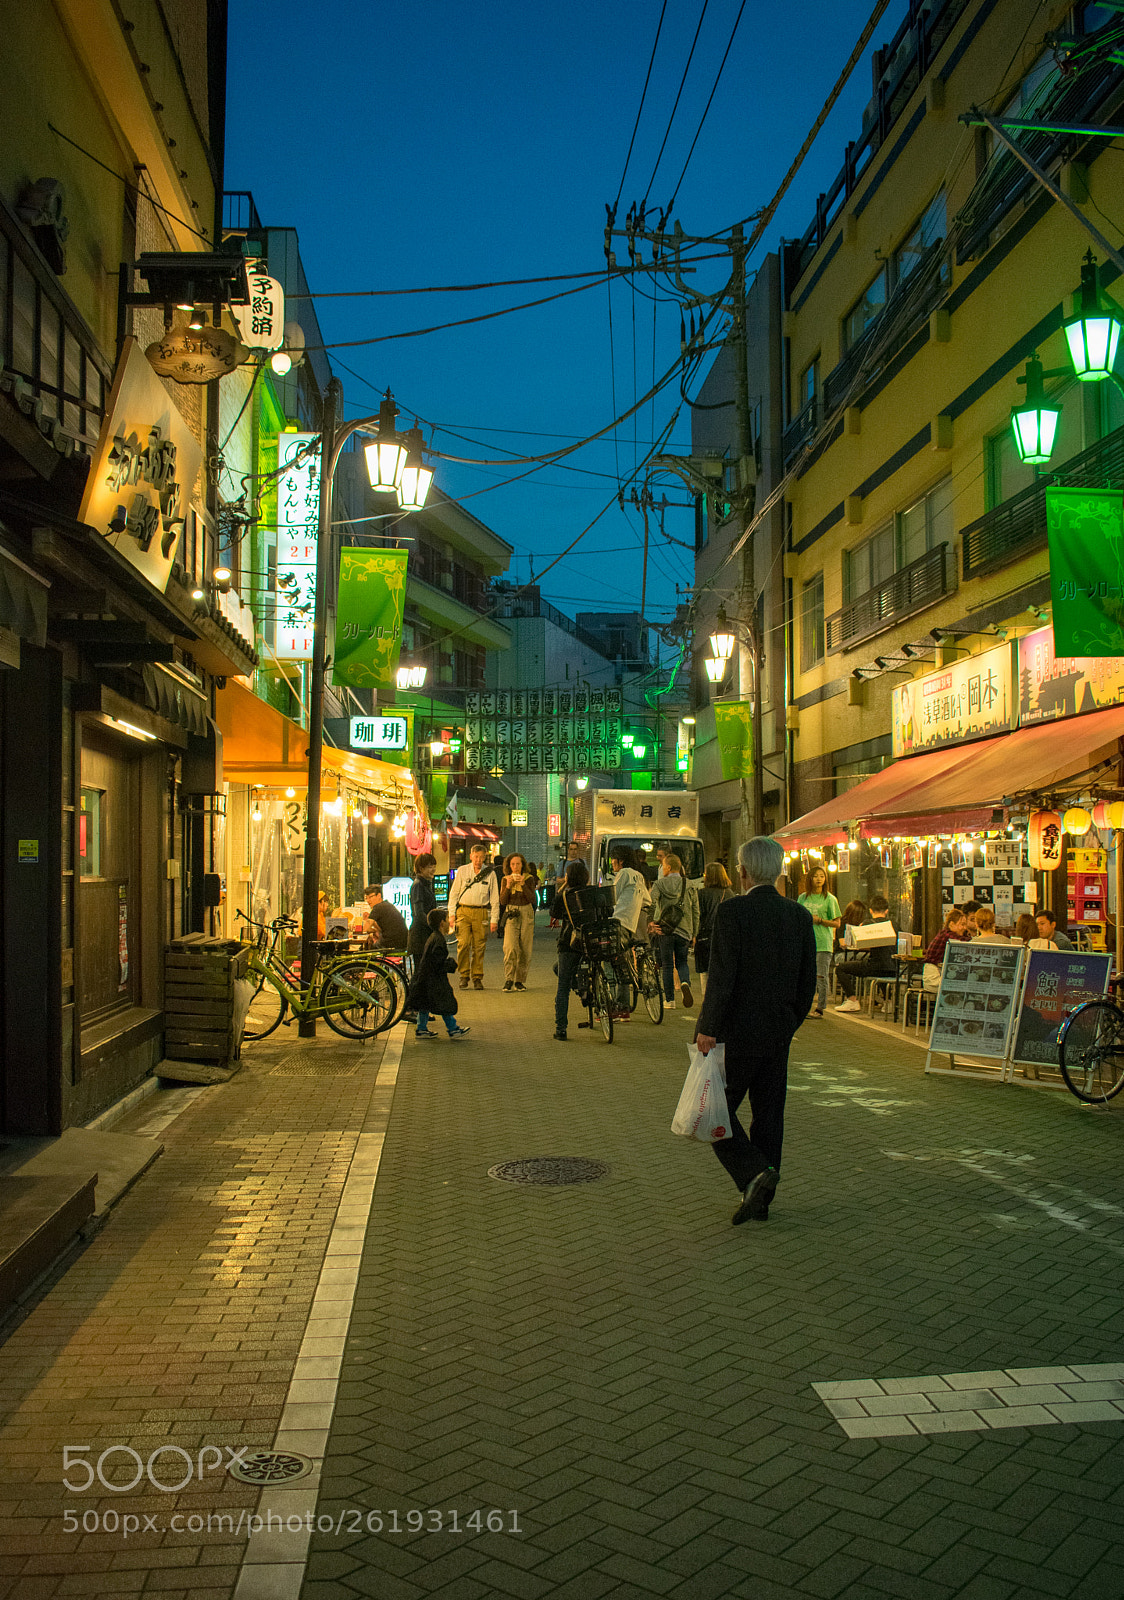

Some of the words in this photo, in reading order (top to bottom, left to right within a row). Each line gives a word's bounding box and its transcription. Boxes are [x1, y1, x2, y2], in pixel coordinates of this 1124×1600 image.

[251, 277, 274, 337] 予約済
[283, 476, 299, 541] もんじゃ
[342, 621, 400, 641] グリーンロード
[354, 721, 402, 743] 珈琲
[497, 722, 508, 743] つくし
[513, 722, 523, 742] つくし
[987, 843, 1019, 854] FREE
